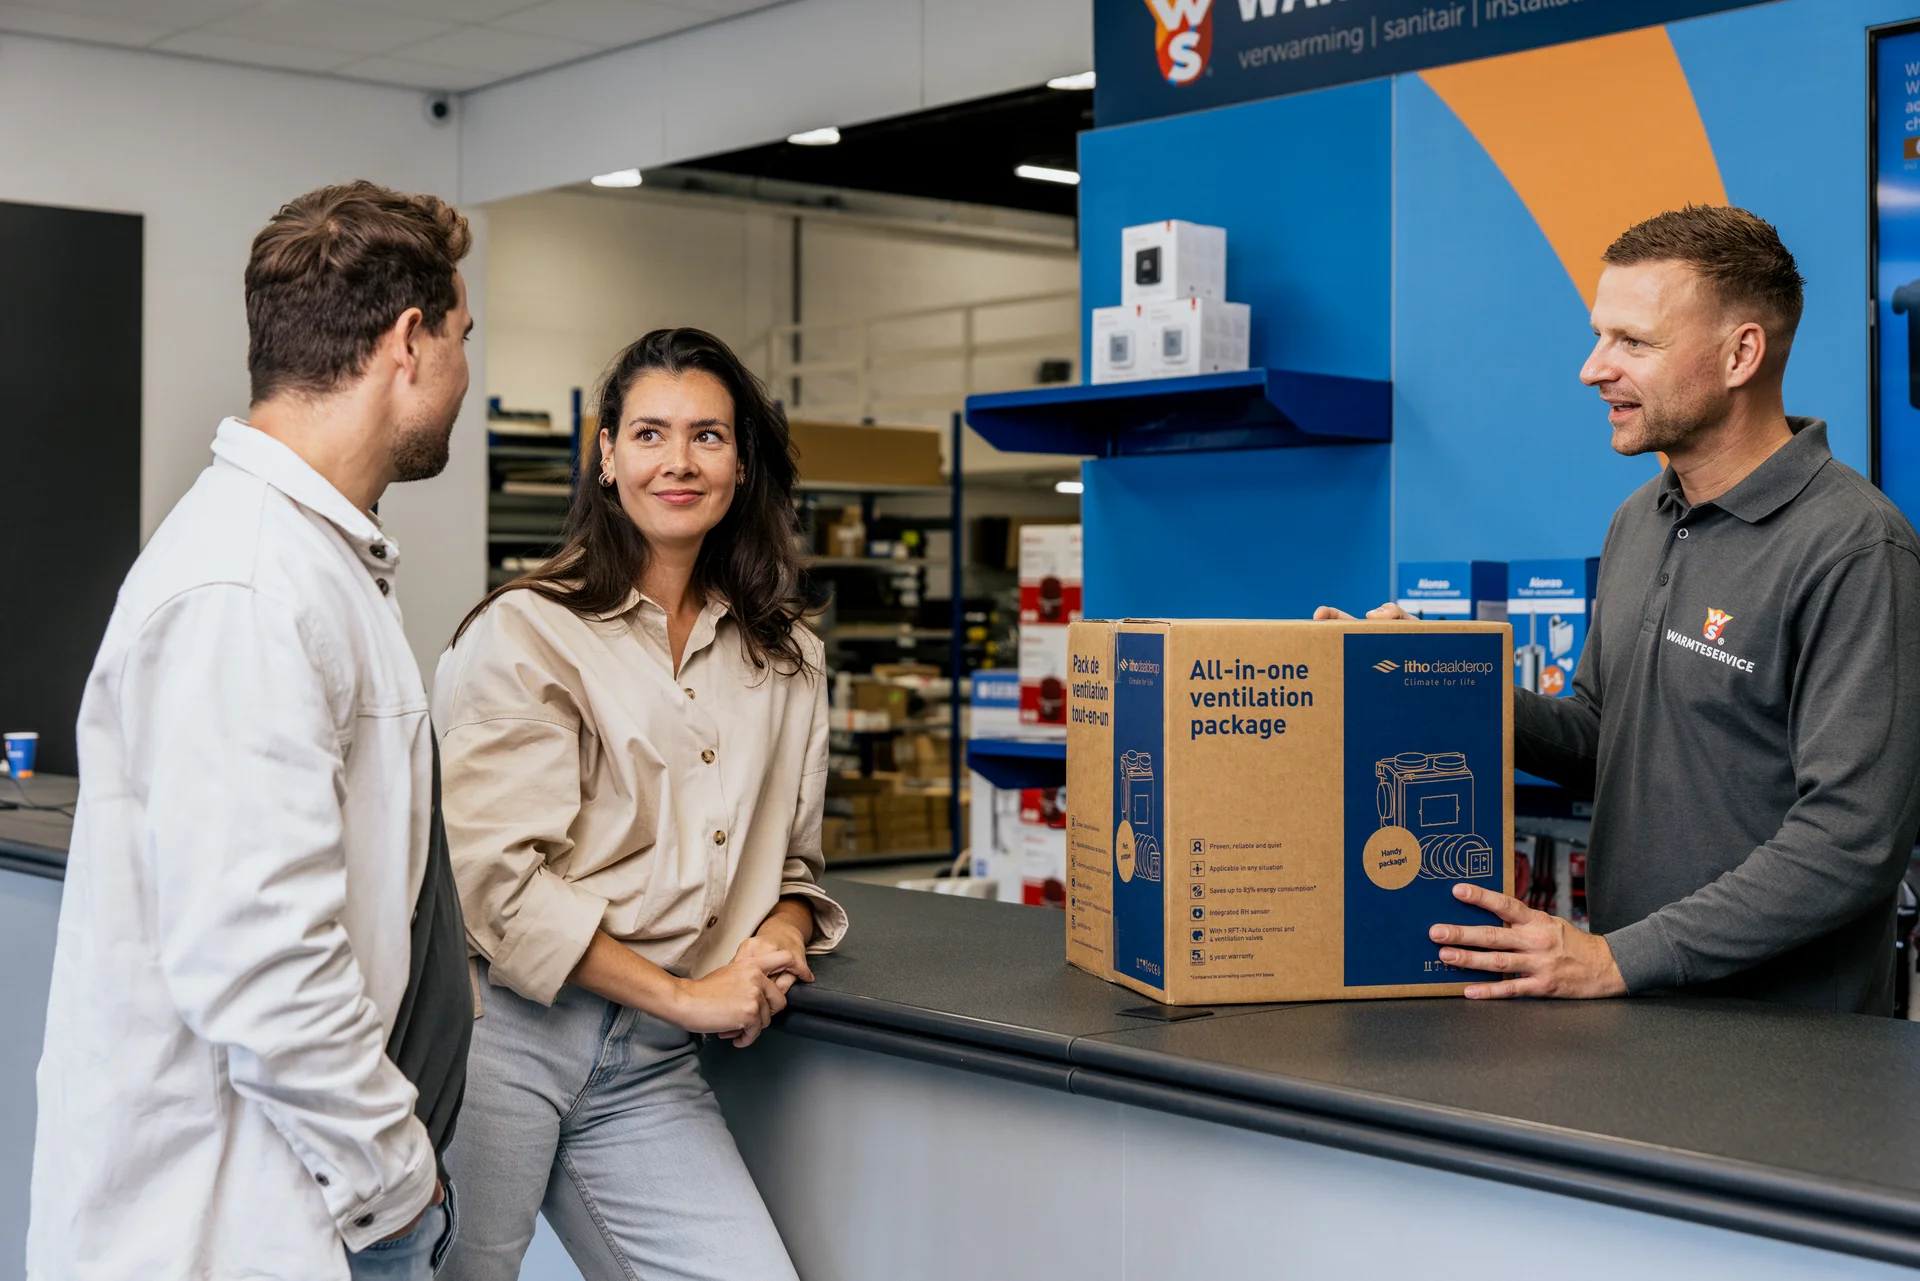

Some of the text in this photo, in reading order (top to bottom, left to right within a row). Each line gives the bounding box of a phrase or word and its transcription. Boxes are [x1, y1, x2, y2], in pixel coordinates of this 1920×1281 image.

[1238, 26, 1365, 69] verwarming
[1383, 5, 1465, 41] sanitair
[1666, 629, 1755, 673] WARMTESERVICE
[1073, 654, 1099, 674] Pack de
[1190, 659, 1309, 680] All-in-one
[1072, 680, 1109, 700] ventilation
[1404, 678, 1475, 686] Climate for life
[1190, 686, 1313, 707] ventilation
[1072, 704, 1109, 727] tout-en-un
[1191, 714, 1286, 740] package
[1381, 848, 1402, 857] Handy
[1379, 857, 1407, 869] package!
[1209, 909, 1239, 917] Integrated
[1214, 954, 1227, 962] year
